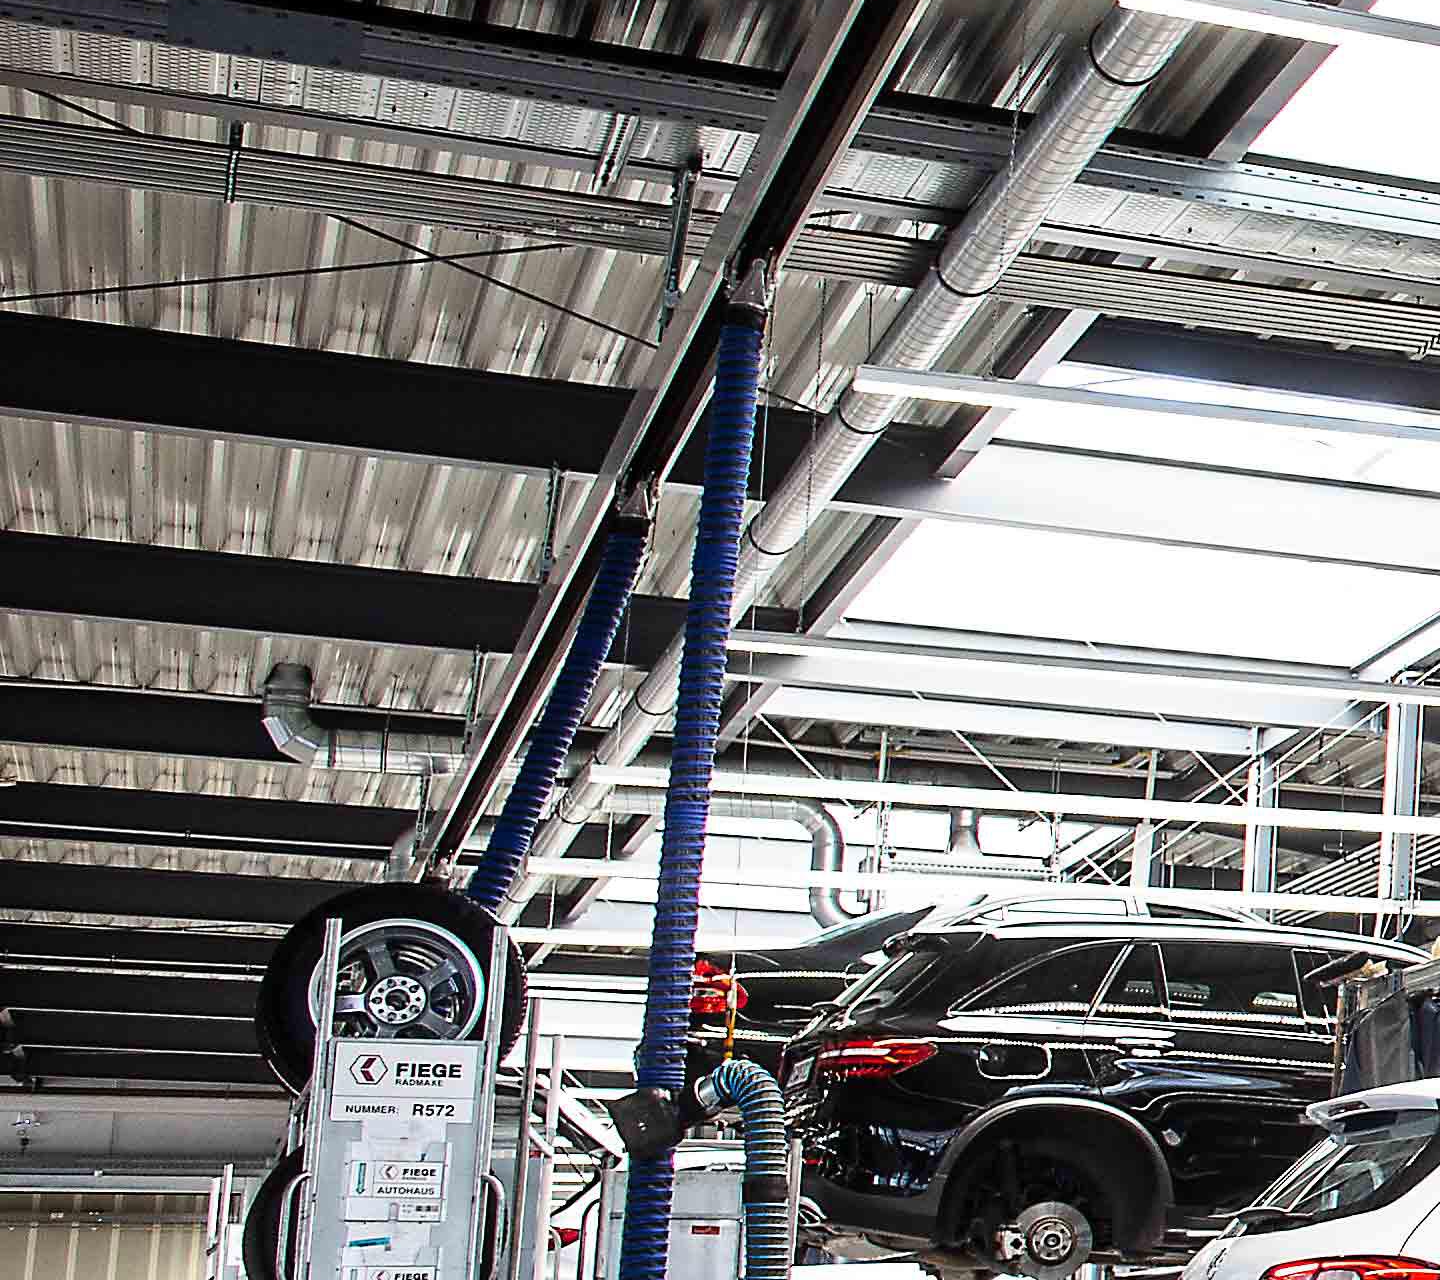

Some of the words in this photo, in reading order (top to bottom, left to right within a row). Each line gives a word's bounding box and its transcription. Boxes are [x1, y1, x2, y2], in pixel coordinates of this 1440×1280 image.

[395, 1063, 463, 1078] FIEGE
[345, 1105, 399, 1114] NUMMER:
[412, 1103, 455, 1117] R572
[402, 1168, 436, 1177] FIEGE
[377, 1186, 435, 1195] AUTOHAUS
[394, 1272, 429, 1280] FIEGE
